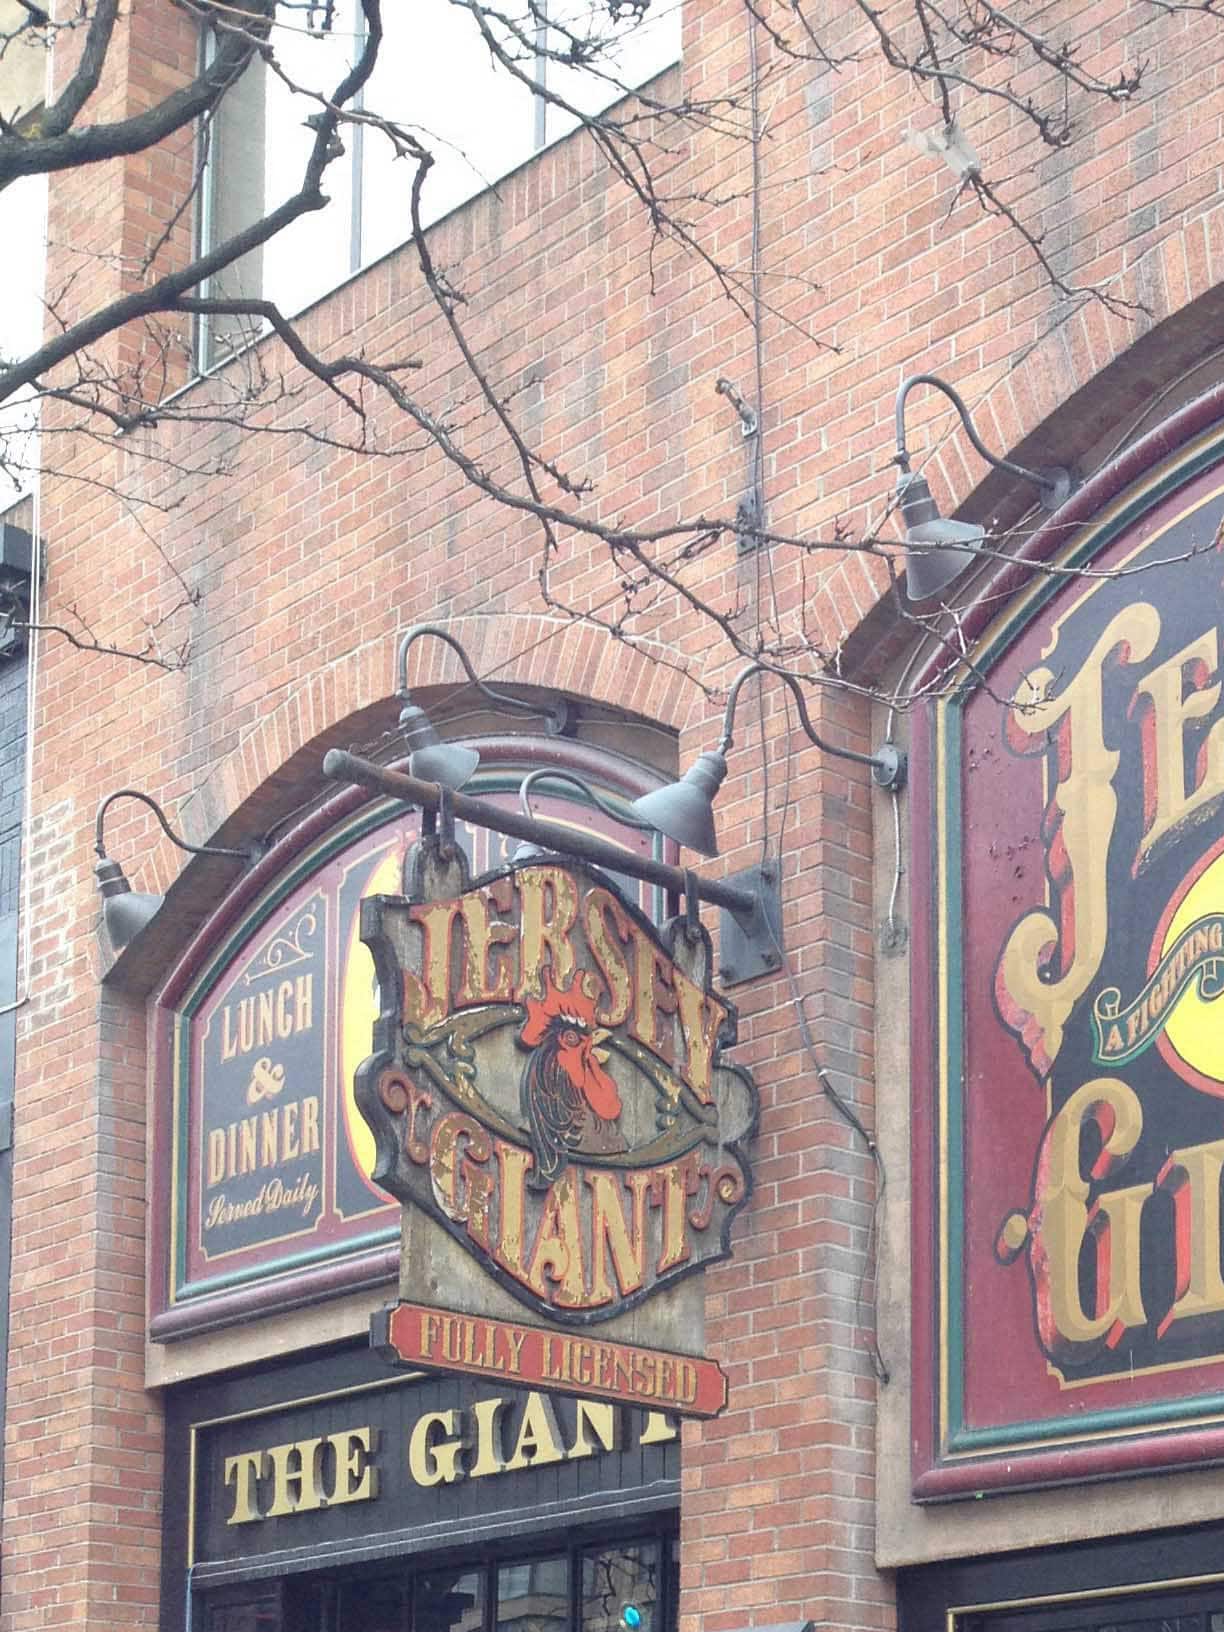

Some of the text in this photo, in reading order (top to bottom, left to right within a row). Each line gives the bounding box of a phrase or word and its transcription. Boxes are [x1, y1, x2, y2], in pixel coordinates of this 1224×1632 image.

[221, 973, 313, 1064] LUNCH
[405, 867, 730, 1104] JERSEY
[1105, 922, 1224, 1051] A FIGHTING
[248, 1057, 286, 1104] &
[207, 1095, 320, 1188] DINNER
[205, 1173, 319, 1231] Served Daily
[430, 1112, 700, 1308] GIANT
[420, 1312, 698, 1404] FULLY LICENSED
[224, 1426, 376, 1525] THE
